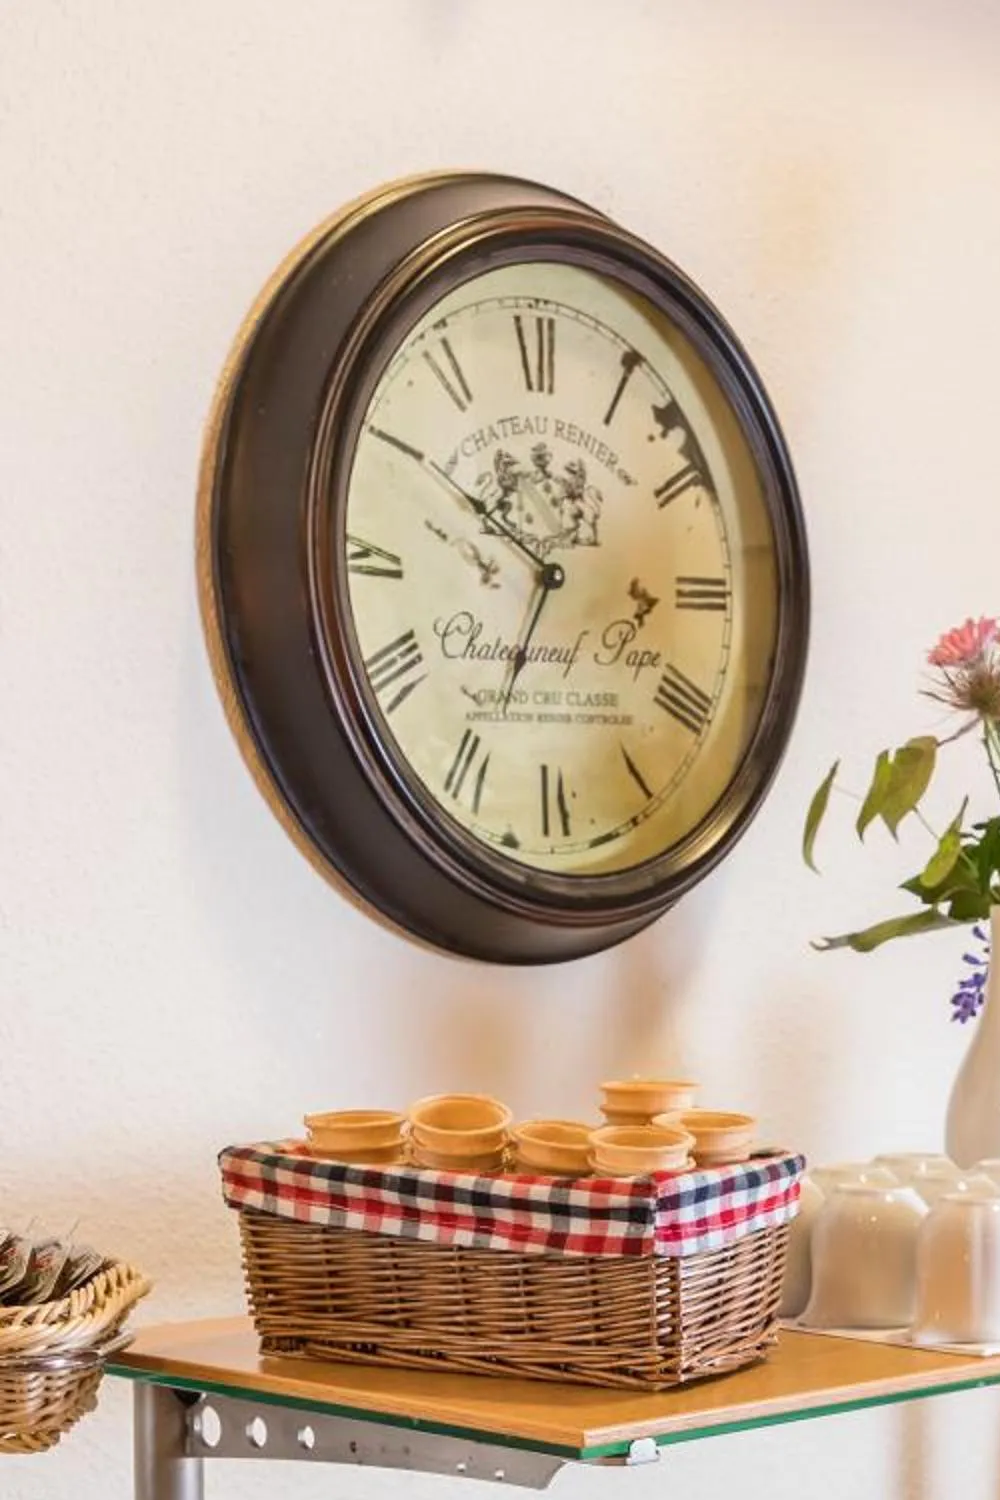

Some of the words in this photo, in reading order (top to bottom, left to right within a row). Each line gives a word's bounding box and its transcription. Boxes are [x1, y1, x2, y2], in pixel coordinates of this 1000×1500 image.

[460, 416, 548, 458] CHATEAU
[554, 417, 619, 473] RENIER
[594, 619, 662, 682] Pape
[476, 689, 529, 706] GRAND
[566, 692, 619, 708] CLASSE
